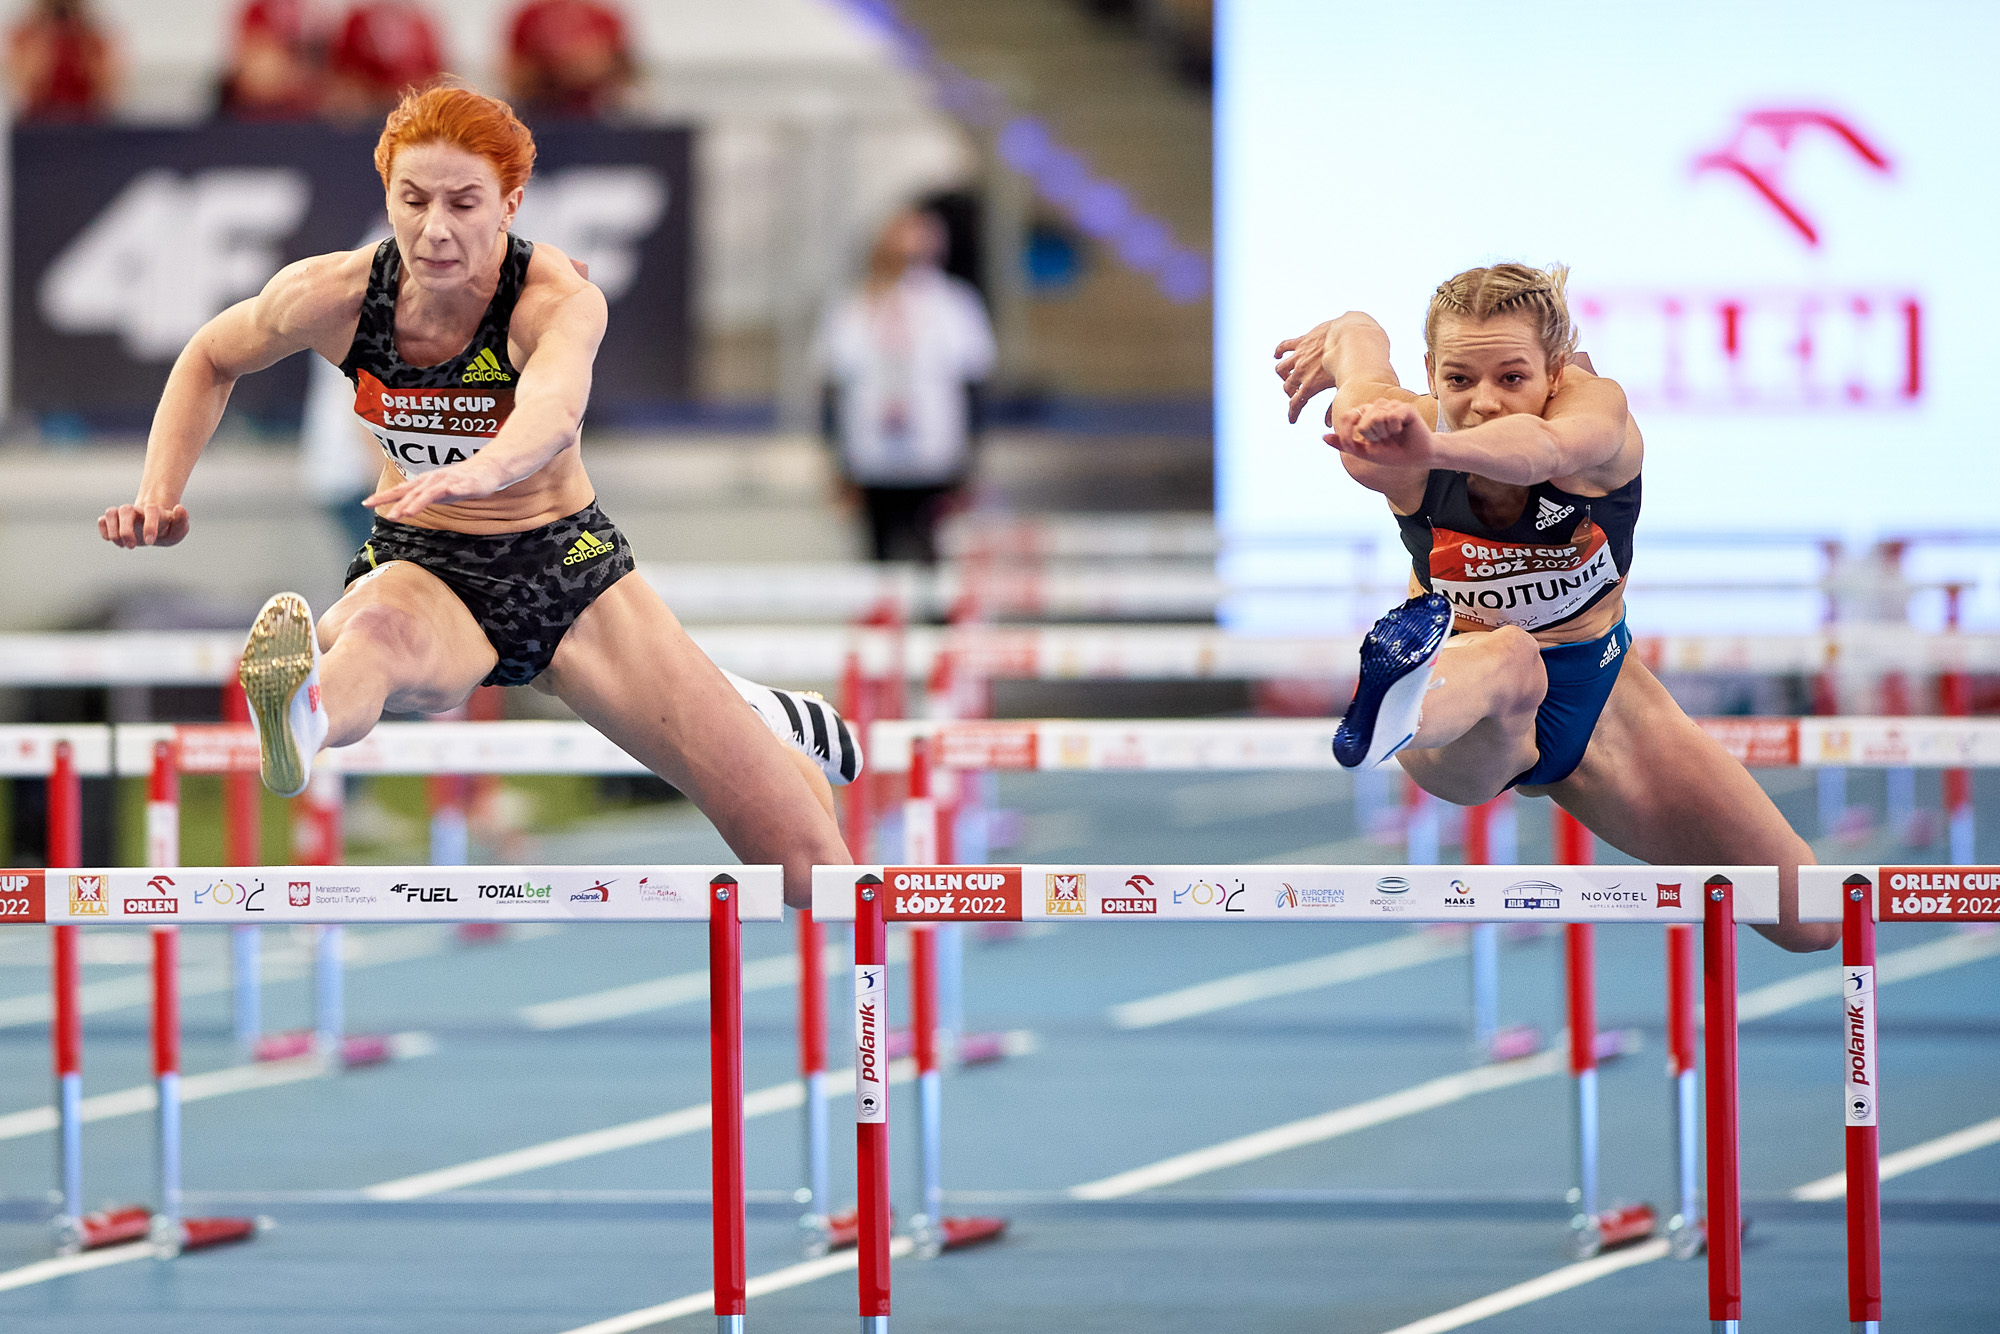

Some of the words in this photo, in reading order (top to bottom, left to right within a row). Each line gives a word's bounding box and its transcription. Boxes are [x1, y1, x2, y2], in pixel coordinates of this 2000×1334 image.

[462, 369, 511, 383] adidas
[381, 392, 450, 411] ORLEN
[453, 396, 496, 412] CUP
[383, 410, 444, 430] ŁÓDŹ
[449, 417, 498, 433] 2022
[1535, 504, 1575, 530] adidas
[563, 541, 615, 566] adidas
[1461, 543, 1532, 560] ORLEN
[1535, 546, 1577, 558] CUP
[1464, 558, 1528, 578] ŁÓDŹ
[1532, 556, 1582, 569] 2022
[1442, 552, 1607, 610] WOJTUNIK
[1600, 645, 1621, 669] adidas
[0, 875, 29, 892] UP
[478, 881, 552, 899] TOTALbet
[894, 874, 962, 890] ORLEN
[965, 874, 1005, 890] CUP
[1889, 873, 1960, 891] ORLEN
[1962, 874, 2000, 891] CUP
[315, 896, 340, 904] Sportu
[344, 896, 377, 904] Turystyki
[407, 888, 458, 902] FUEL
[570, 892, 601, 902] polanik
[1581, 892, 1647, 901] NOVOTEL
[1660, 889, 1679, 900] ibis
[1891, 892, 1952, 914] ŁÓDŹ
[1957, 897, 2000, 914] 2022
[71, 902, 106, 914] PZLA
[126, 900, 176, 913] ORLEN
[895, 893, 955, 914] ŁÓDŹ
[959, 898, 1005, 914] 2022
[1048, 901, 1083, 913] PZLA
[1104, 900, 1154, 912] ORLEN
[859, 1002, 880, 1083] polanik
[1847, 1003, 1870, 1086] polanik
